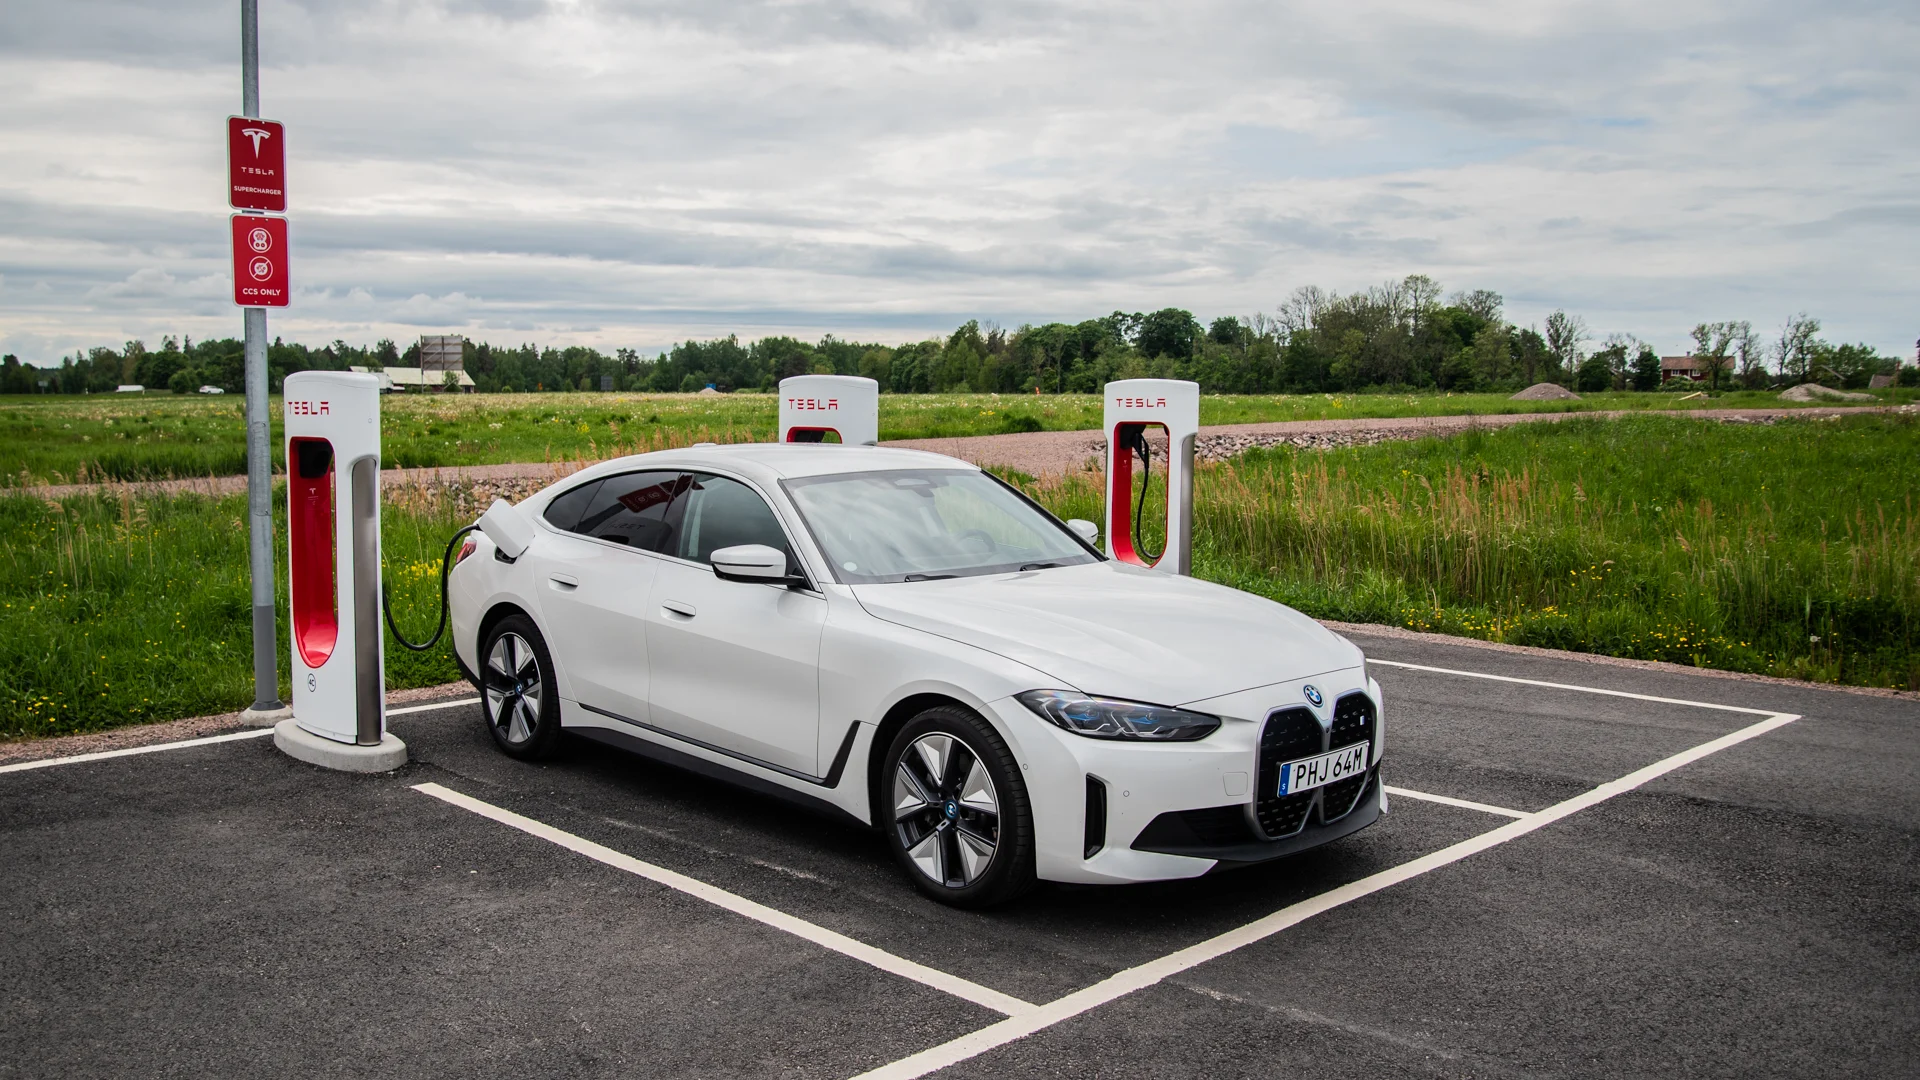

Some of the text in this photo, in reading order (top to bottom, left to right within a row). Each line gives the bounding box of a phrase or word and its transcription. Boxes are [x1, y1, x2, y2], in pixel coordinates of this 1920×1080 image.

[241, 167, 275, 176] TESLA
[233, 186, 282, 195] SUPERCHARGER
[260, 288, 281, 296] ONLY
[788, 399, 838, 410] TESLA
[1116, 398, 1166, 408] TESLA
[288, 401, 329, 416] TESLA
[1295, 747, 1363, 789] PHJ 64M
